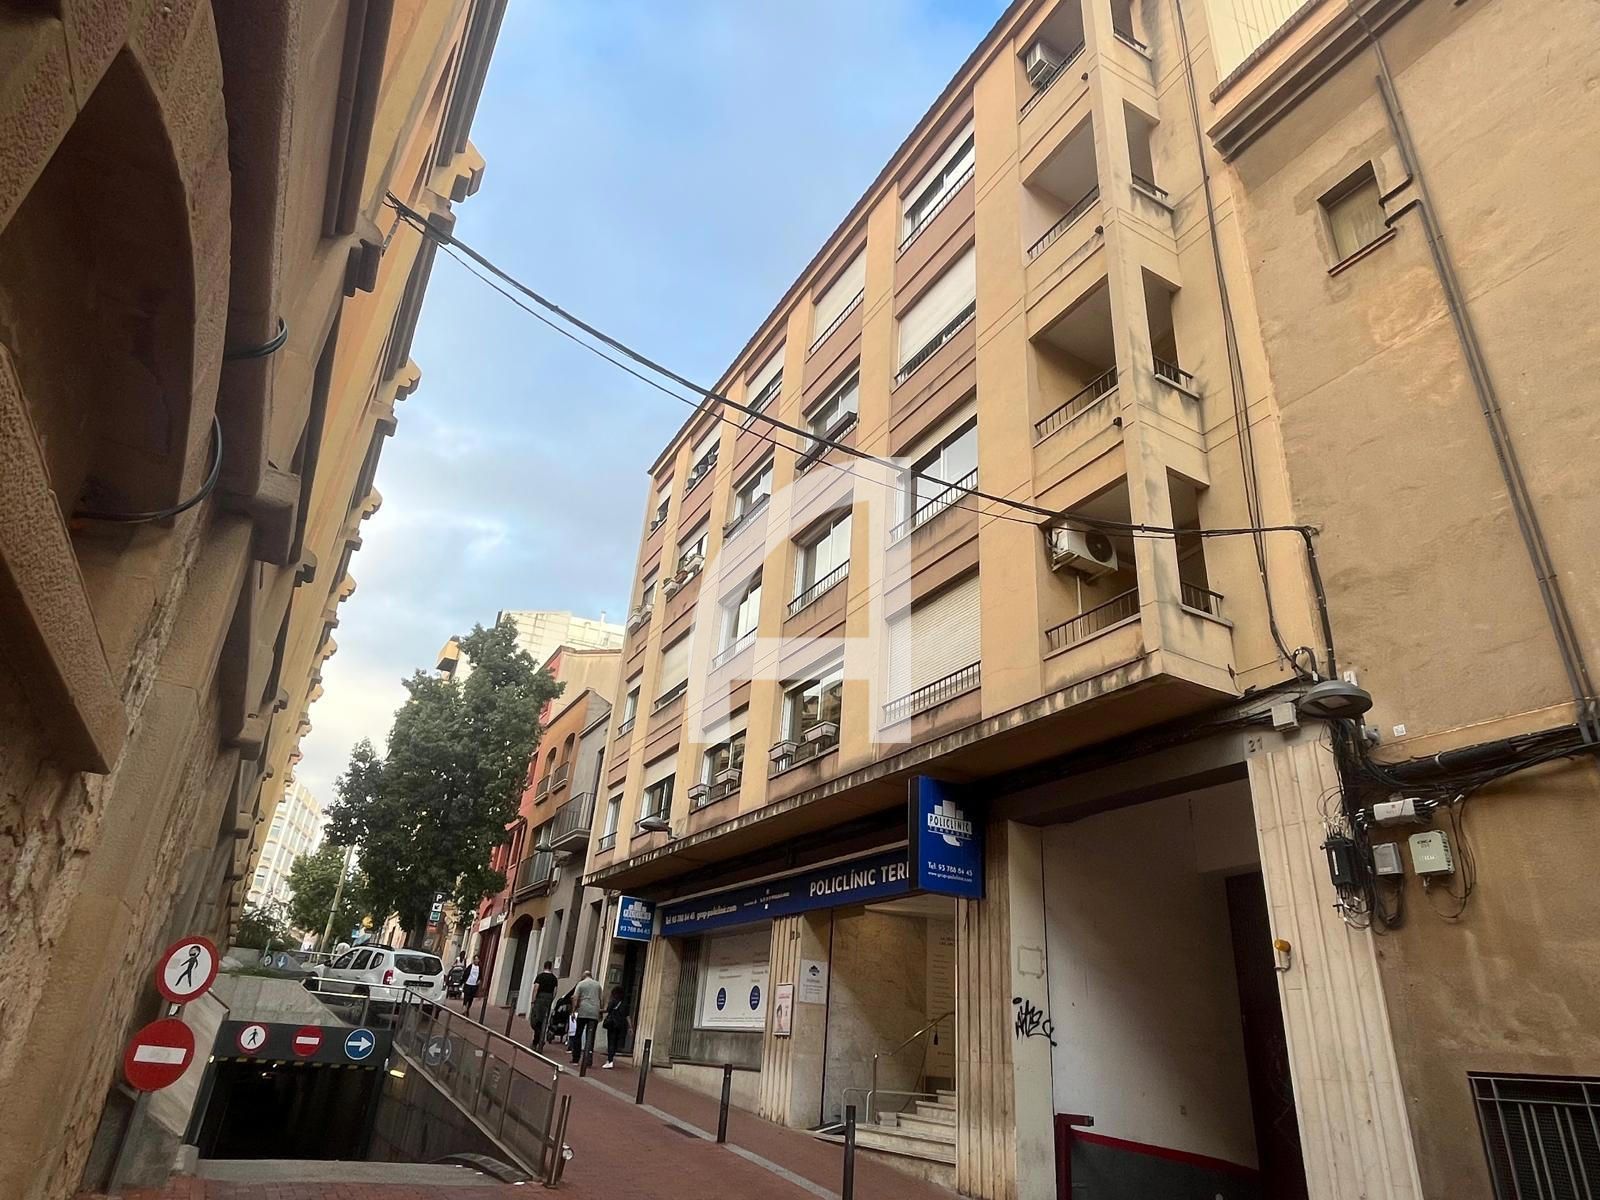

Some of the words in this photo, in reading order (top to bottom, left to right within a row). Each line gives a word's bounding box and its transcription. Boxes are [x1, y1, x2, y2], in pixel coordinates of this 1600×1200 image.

[1248, 736, 1263, 752] 21
[810, 869, 876, 897] POLICLÍNIC
[436, 894, 443, 902] P
